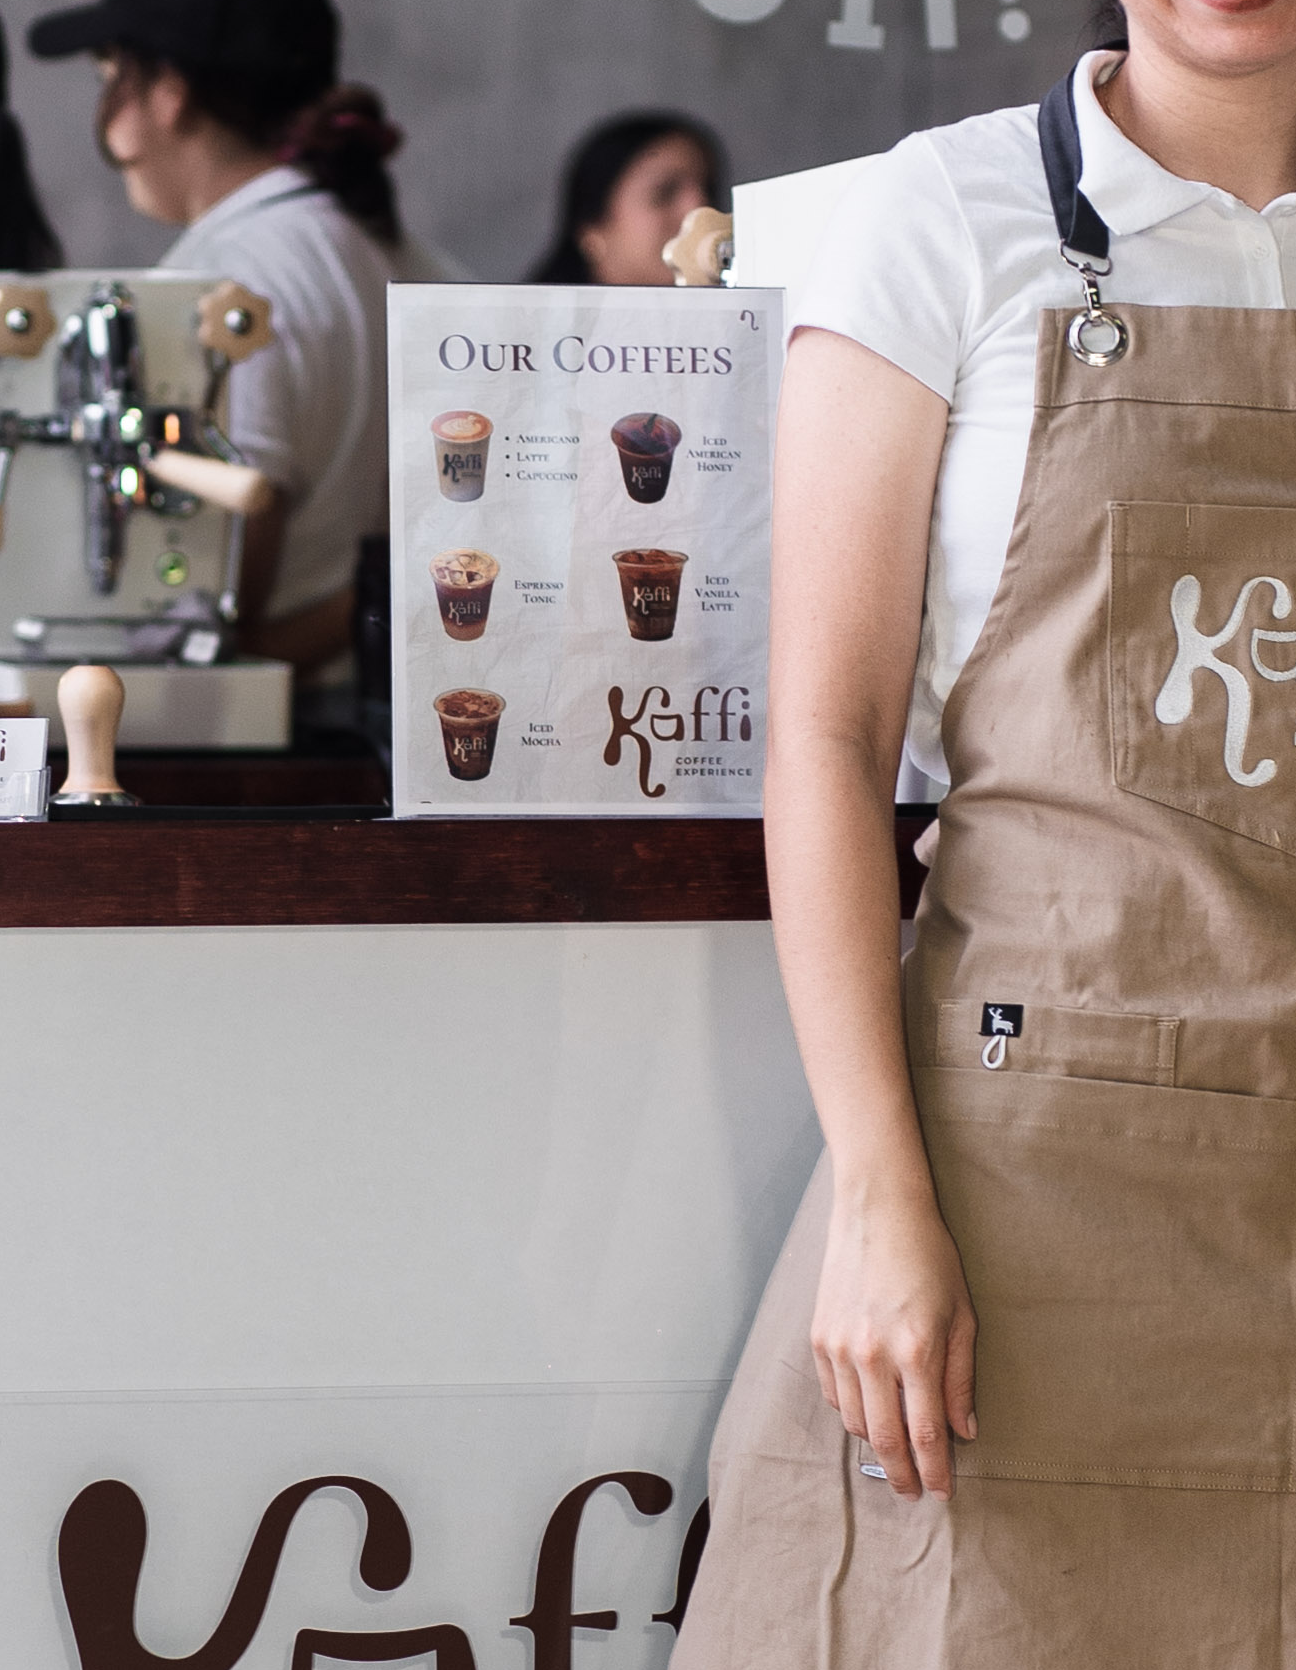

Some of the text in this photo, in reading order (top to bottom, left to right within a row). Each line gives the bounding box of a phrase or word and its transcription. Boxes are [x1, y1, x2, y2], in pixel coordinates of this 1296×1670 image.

[604, 685, 752, 798] Kaffi
[675, 756, 723, 765] COFFEE
[675, 768, 753, 776] EXPERIENCE
